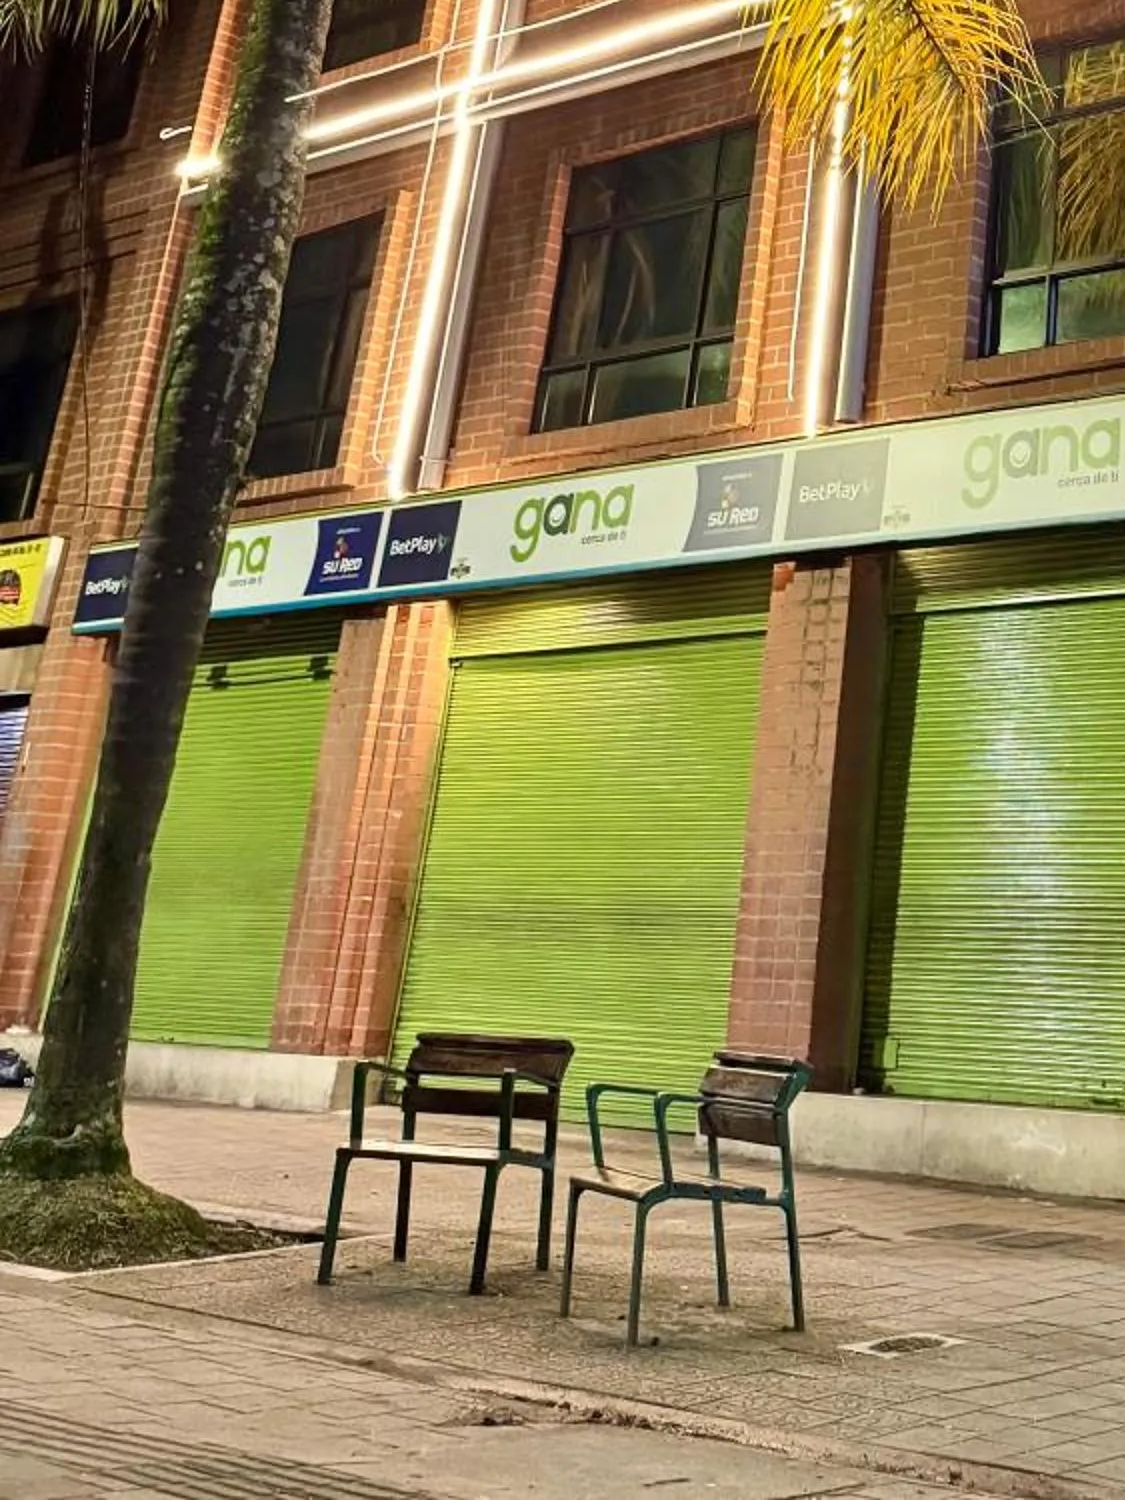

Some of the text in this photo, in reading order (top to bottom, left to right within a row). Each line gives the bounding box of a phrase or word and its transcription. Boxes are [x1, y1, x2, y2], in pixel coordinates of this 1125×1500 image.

[961, 417, 1122, 509] gana
[800, 481, 860, 503] BetPlay
[510, 484, 634, 563] gana
[707, 511, 728, 528] SU
[221, 536, 272, 577] na
[389, 535, 436, 556] BetPlay
